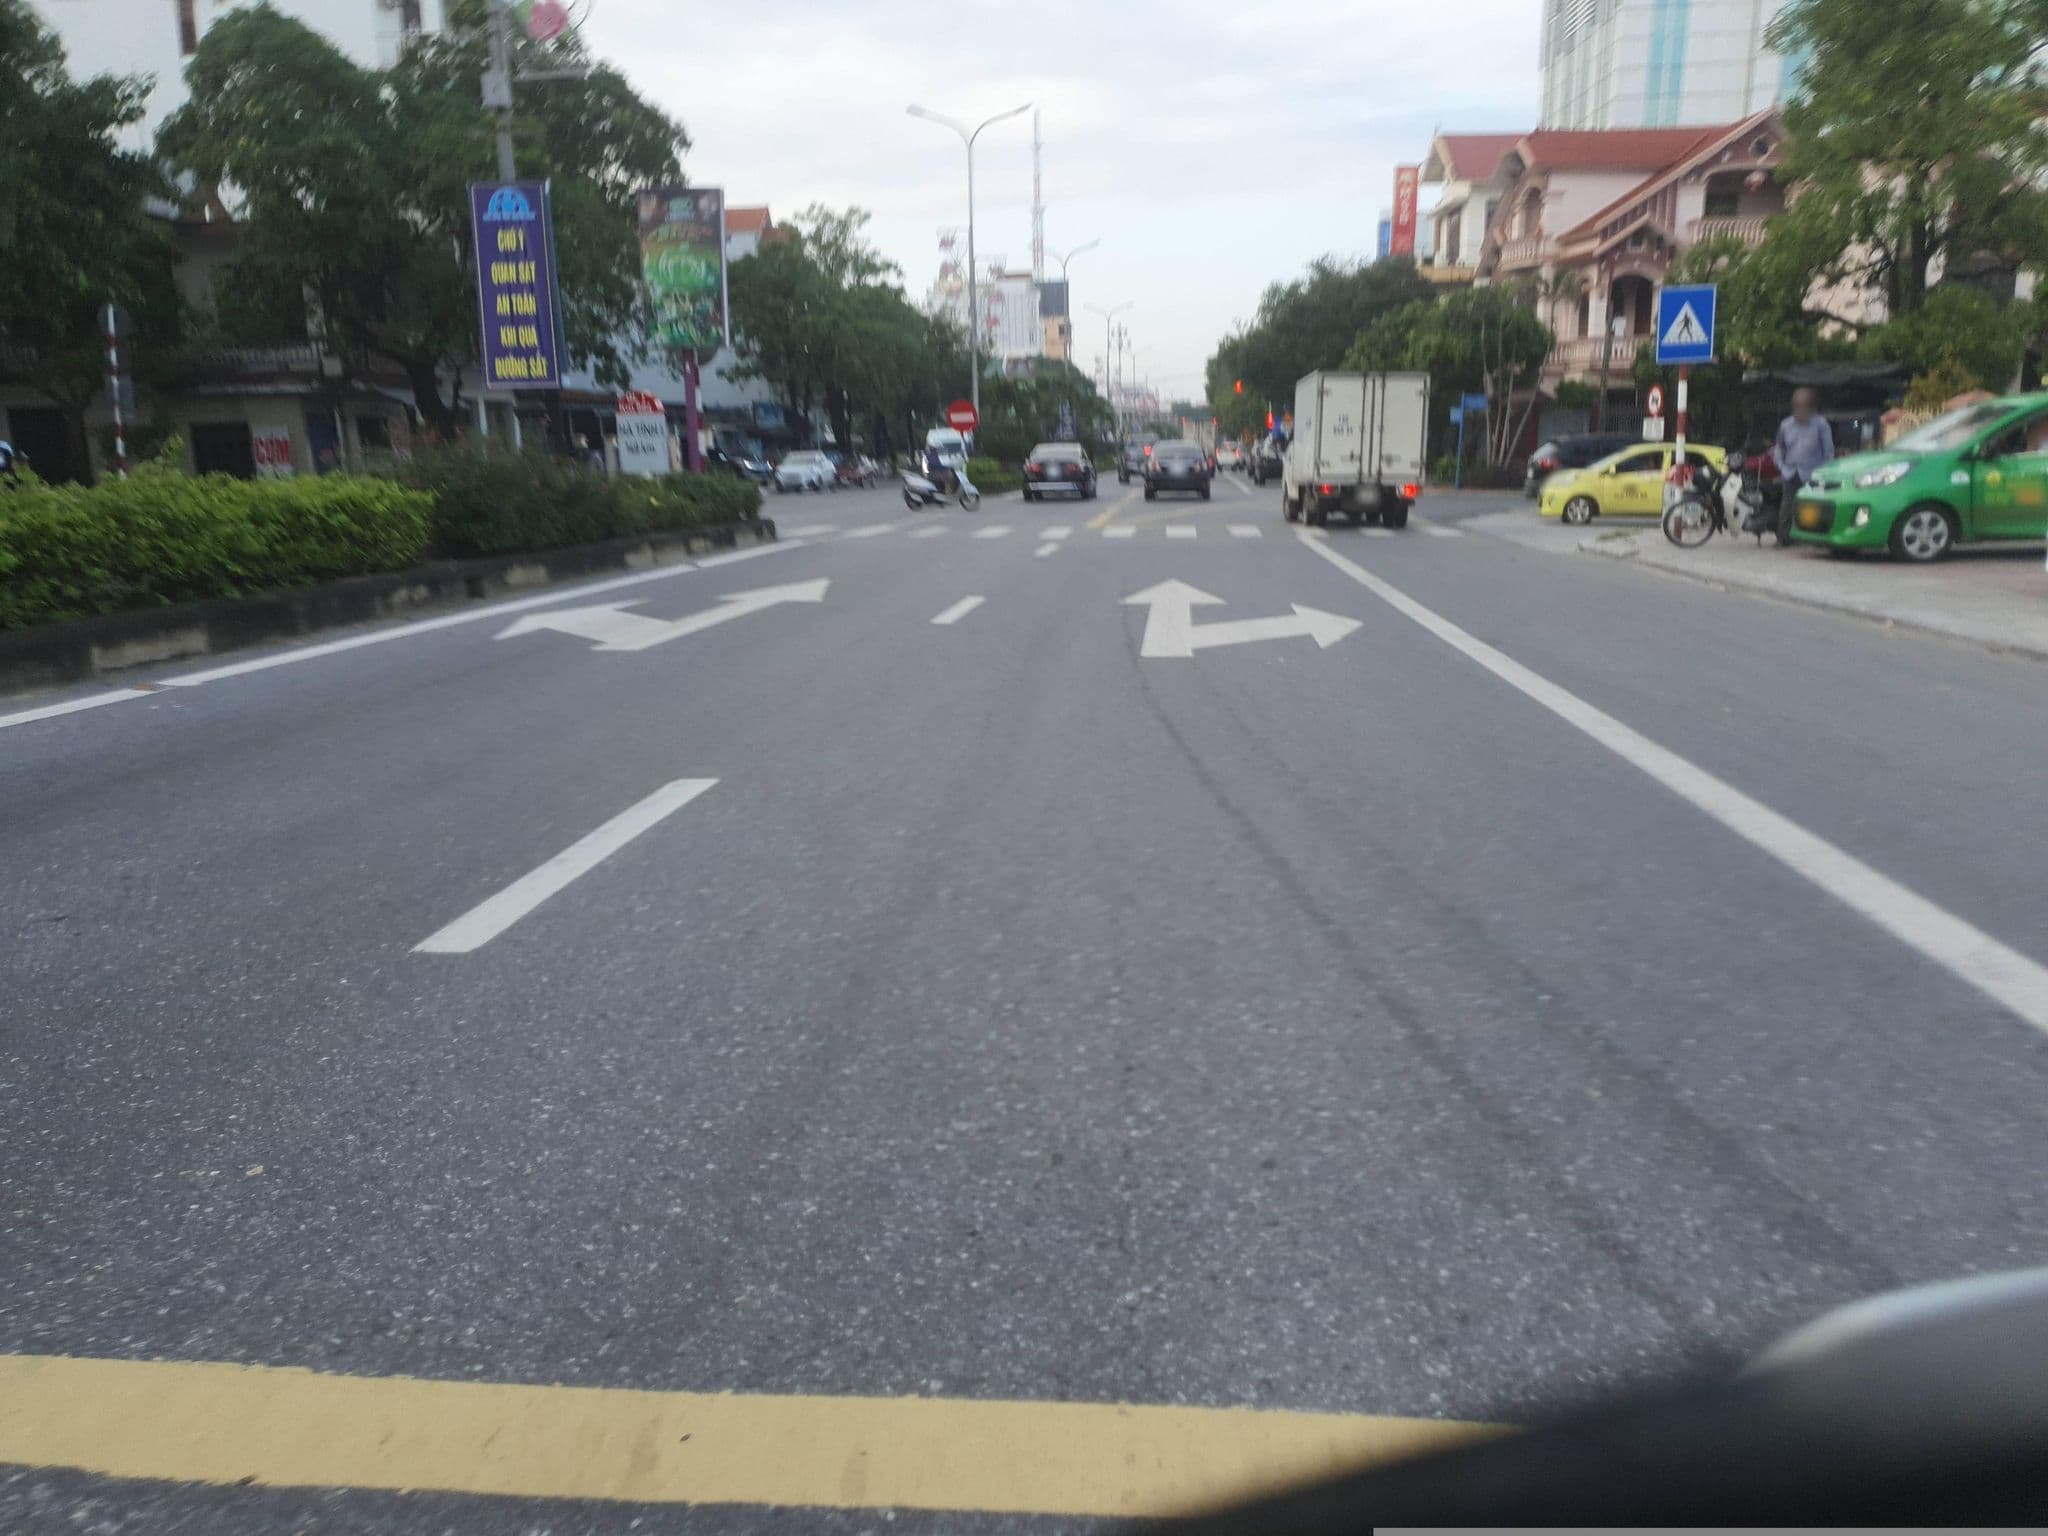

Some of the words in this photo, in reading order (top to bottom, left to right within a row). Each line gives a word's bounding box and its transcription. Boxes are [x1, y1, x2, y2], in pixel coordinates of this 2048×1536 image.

[491, 262, 516, 285] QUAN
[497, 294, 511, 317] AN
[512, 290, 537, 316] TOÀN
[500, 326, 517, 348] KHI
[519, 326, 538, 348] QUA
